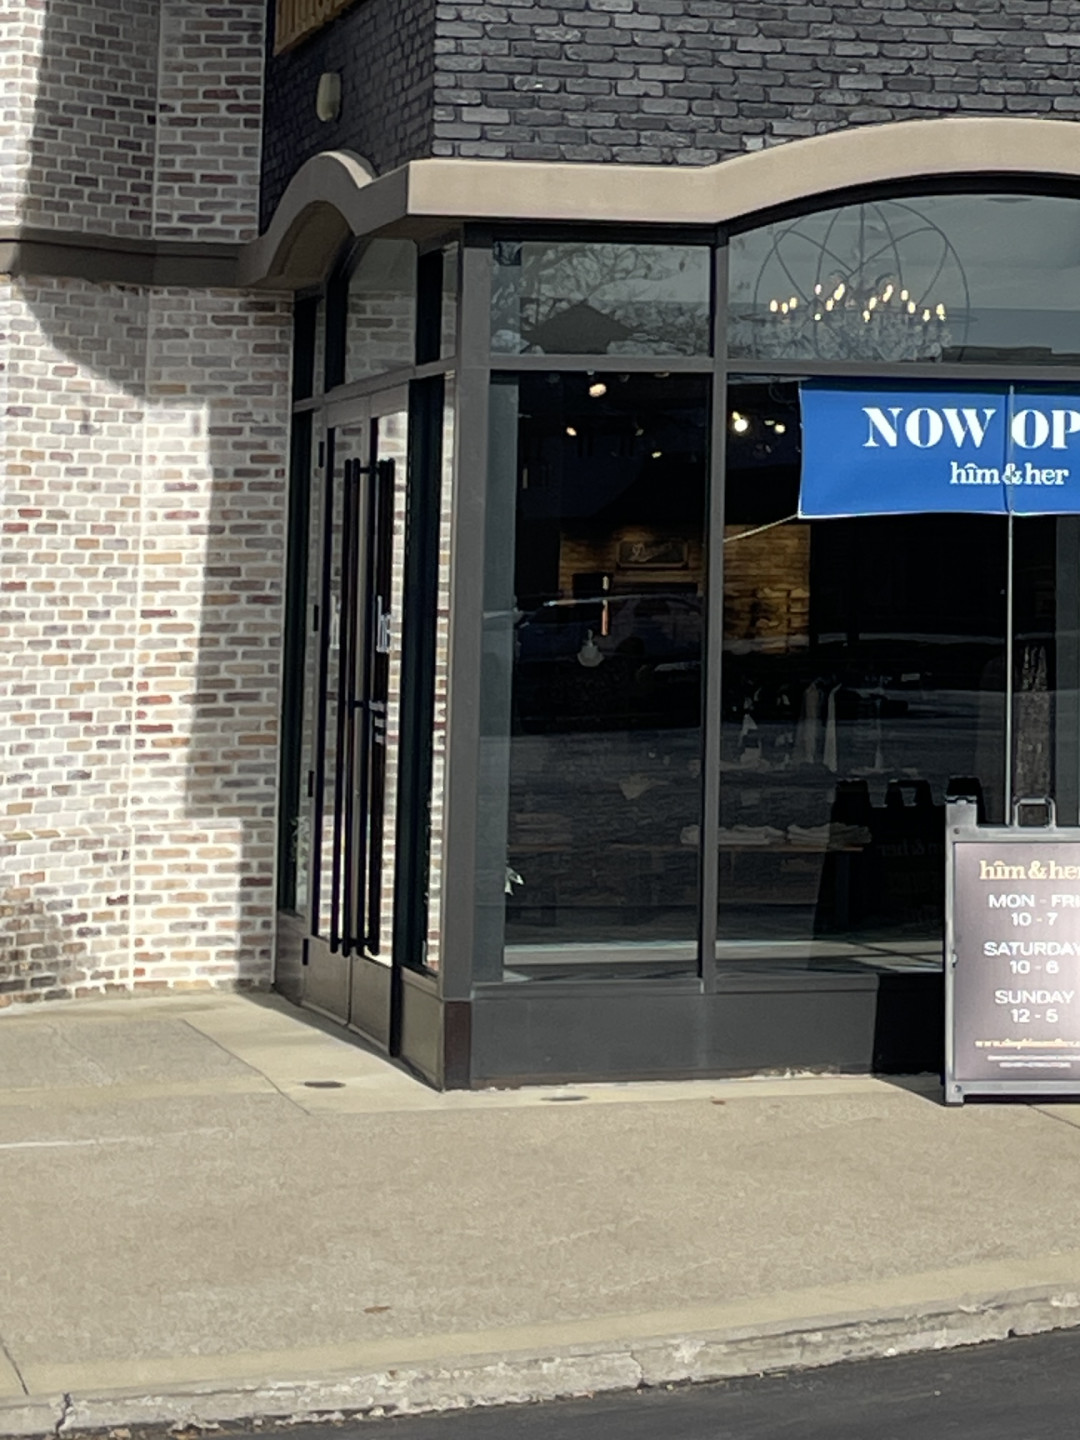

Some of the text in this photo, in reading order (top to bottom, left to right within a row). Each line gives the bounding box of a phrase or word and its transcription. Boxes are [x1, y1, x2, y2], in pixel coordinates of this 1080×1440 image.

[862, 407, 996, 448] NOW
[988, 894, 1035, 908] MON
[1051, 894, 1080, 908] FRI
[1011, 912, 1032, 926] 10
[1046, 912, 1058, 926] 7
[1010, 959, 1031, 974] 10
[994, 990, 1075, 1004] SUNDAY
[1011, 1008, 1031, 1023] 12
[1046, 1008, 1059, 1023] 5
